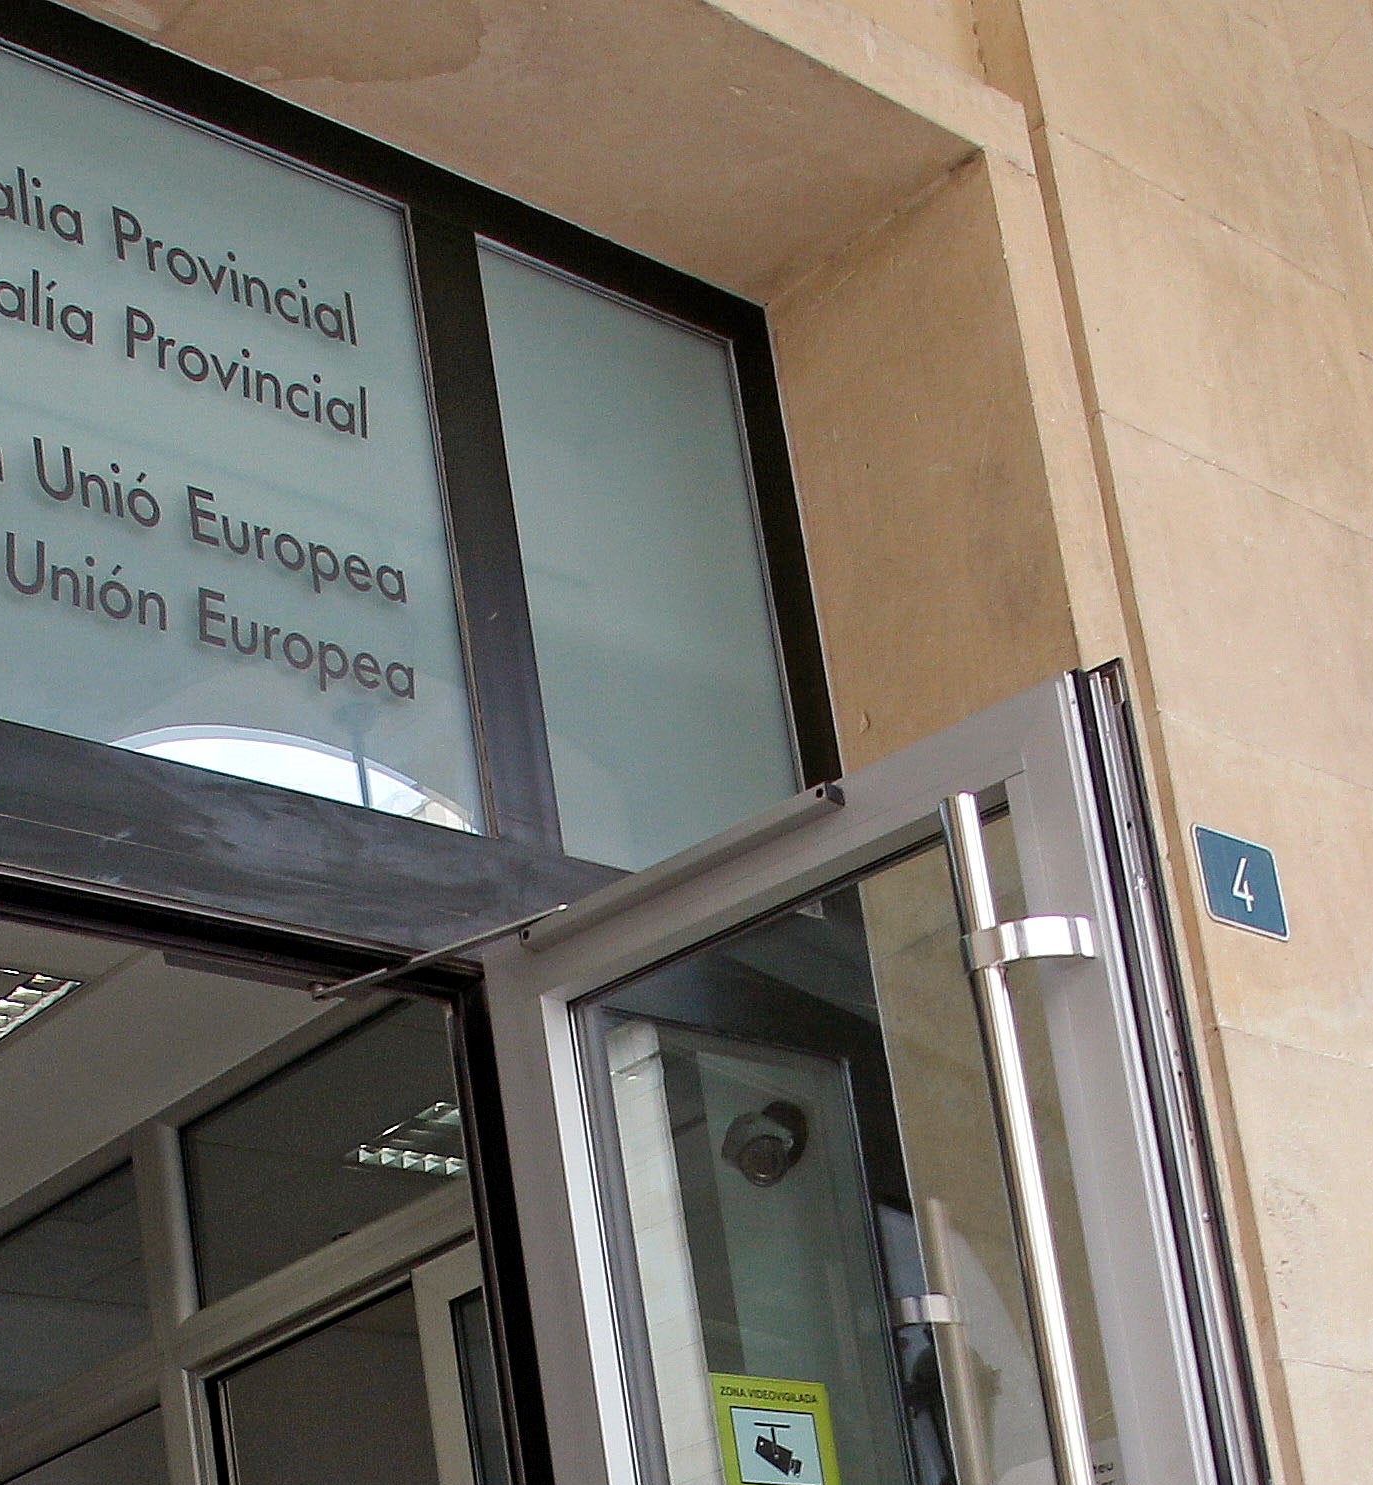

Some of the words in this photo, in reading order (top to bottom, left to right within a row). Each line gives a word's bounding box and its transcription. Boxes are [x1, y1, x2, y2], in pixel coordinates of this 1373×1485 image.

[111, 205, 358, 347] Provincial
[125, 305, 368, 440] Provincial
[32, 436, 161, 528] Unió
[186, 484, 407, 604] Europea
[5, 531, 167, 631] Unión
[197, 586, 415, 700] Europea
[1232, 857, 1254, 912] 4
